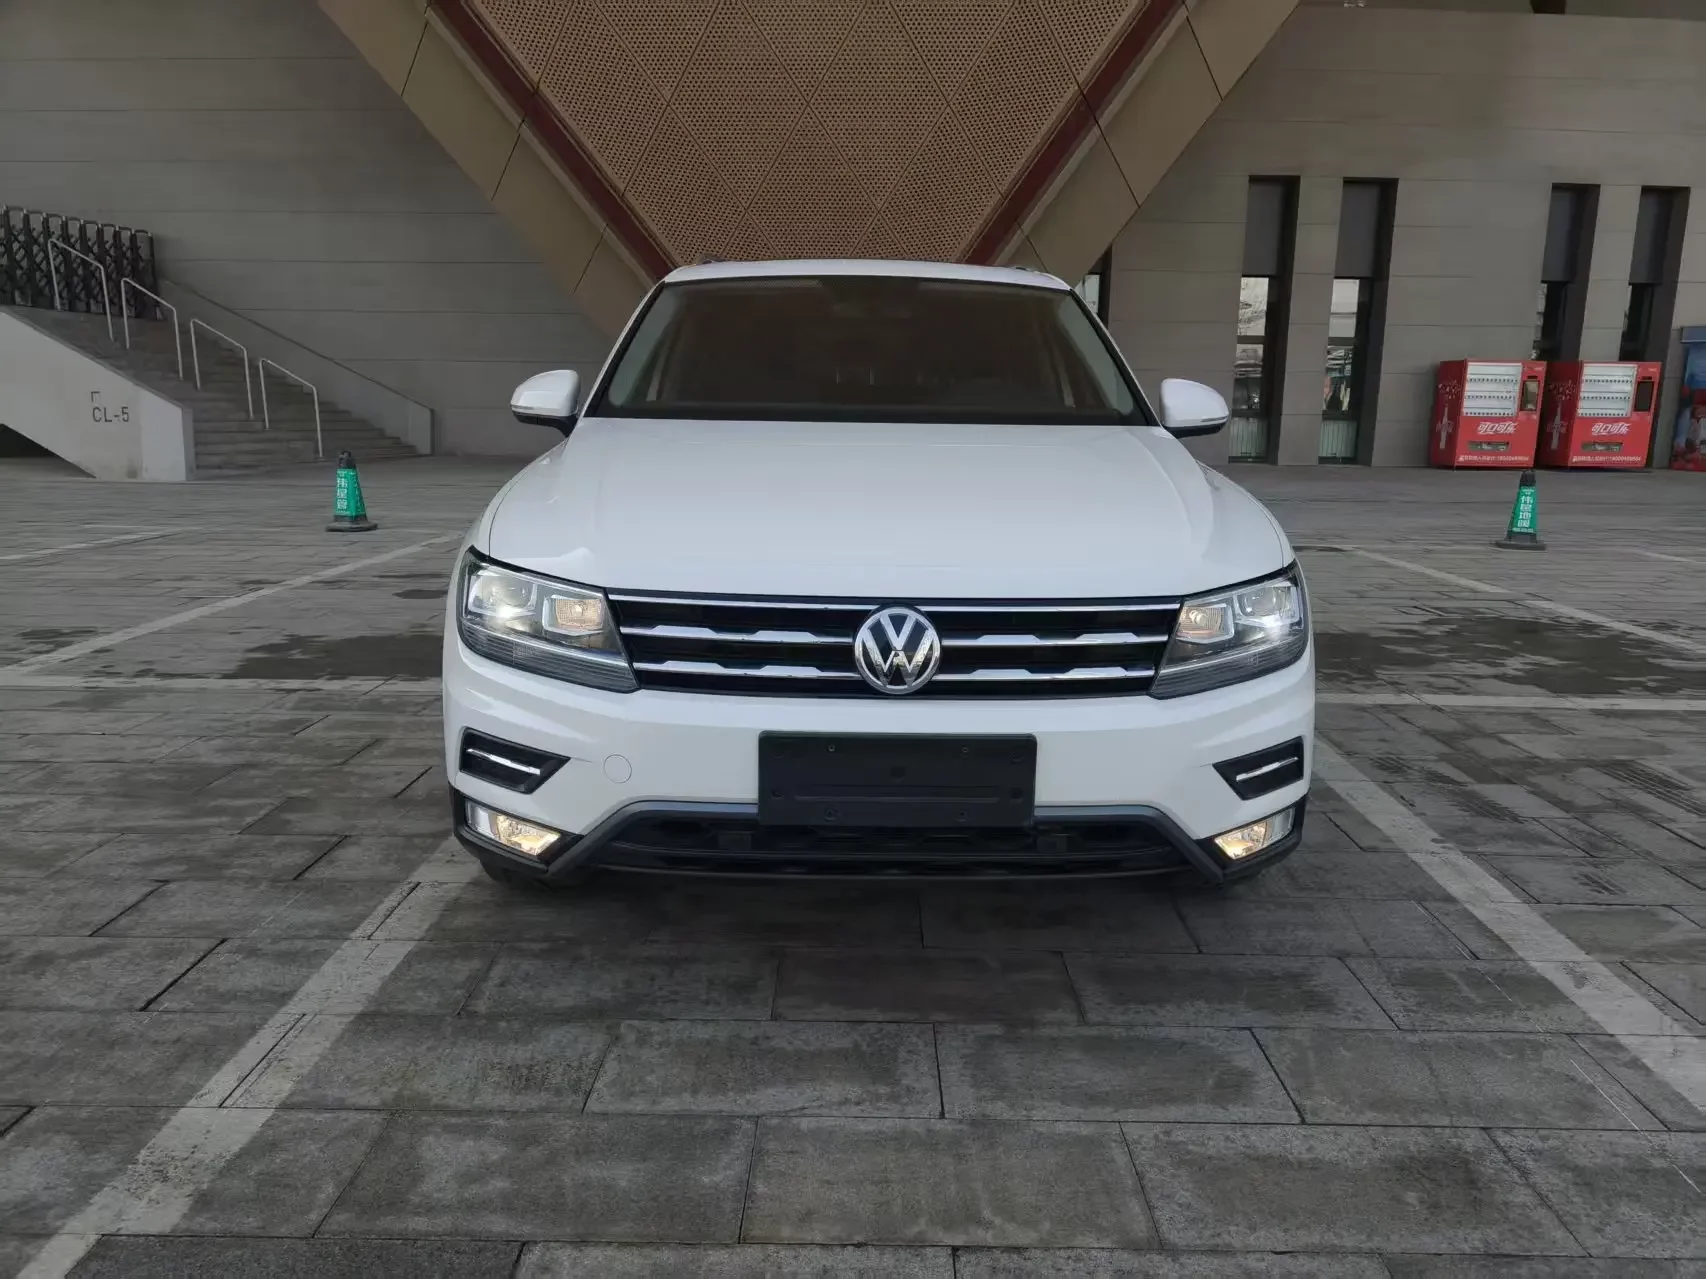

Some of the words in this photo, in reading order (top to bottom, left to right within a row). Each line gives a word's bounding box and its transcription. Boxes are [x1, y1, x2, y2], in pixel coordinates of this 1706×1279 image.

[92, 406, 129, 422] CL-5
[1478, 421, 1518, 435] 可口可乐
[1592, 422, 1632, 436] 可口可乐
